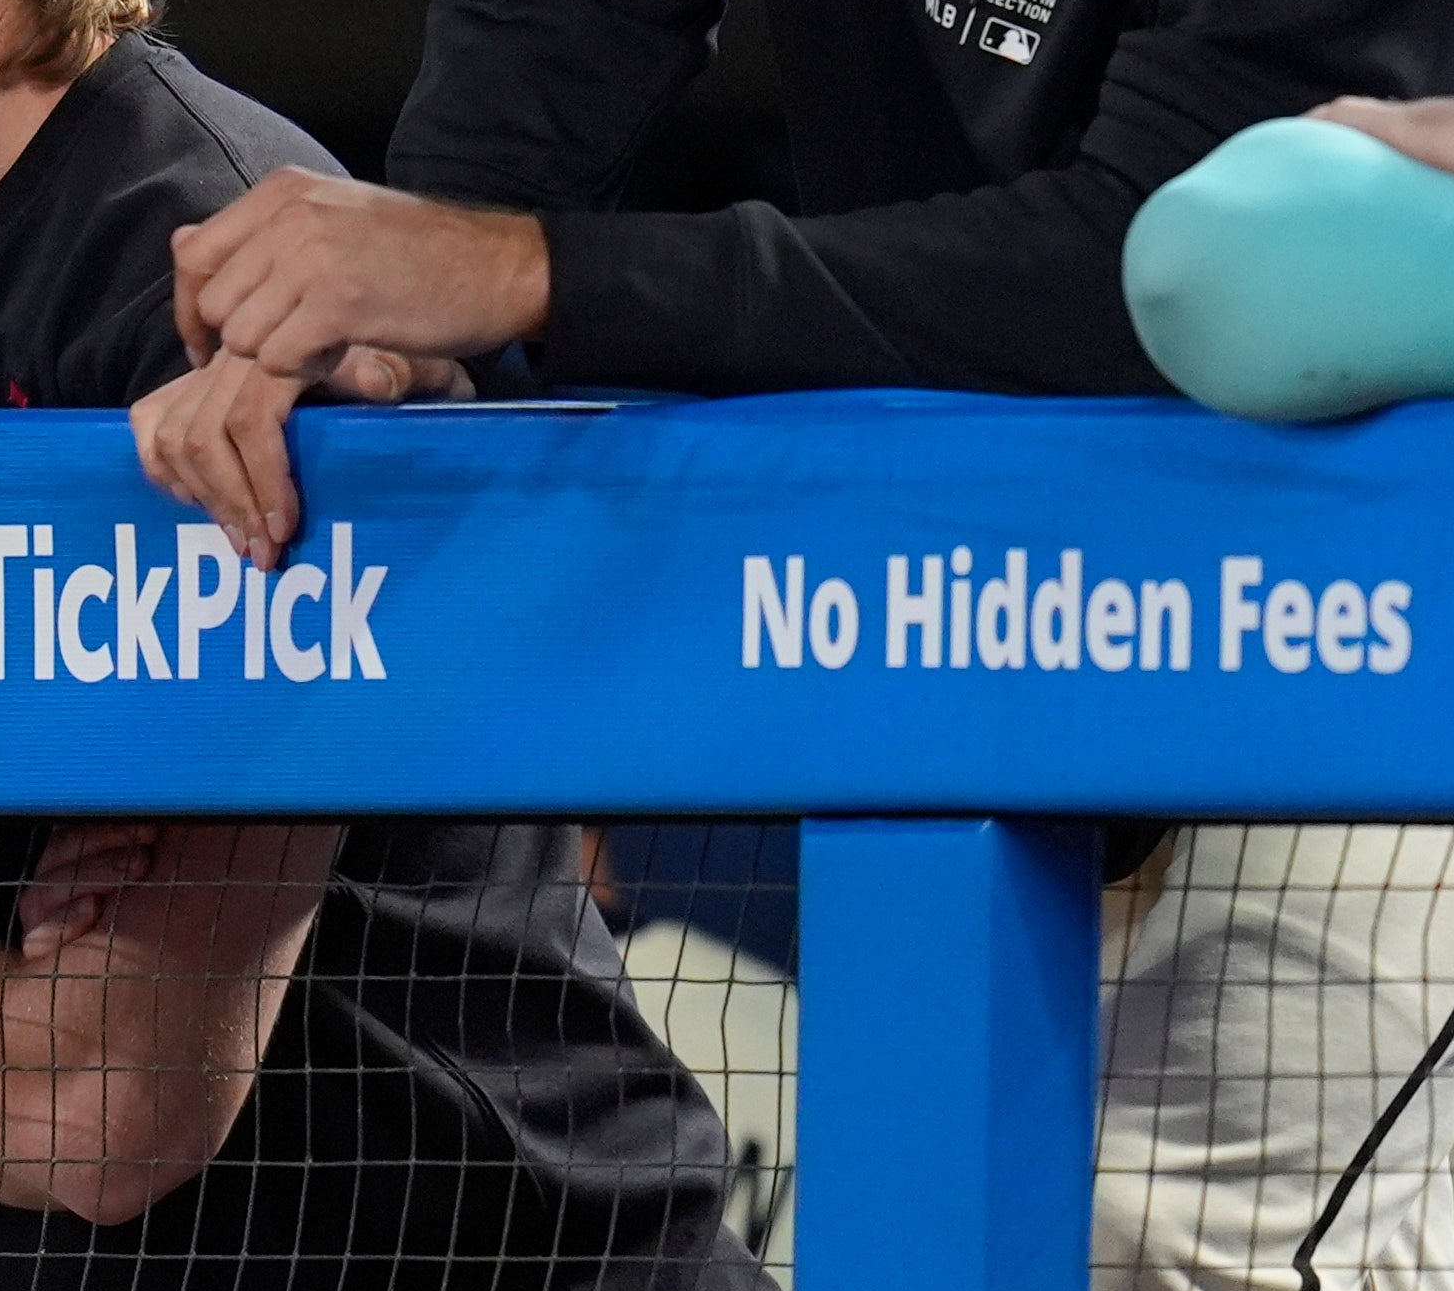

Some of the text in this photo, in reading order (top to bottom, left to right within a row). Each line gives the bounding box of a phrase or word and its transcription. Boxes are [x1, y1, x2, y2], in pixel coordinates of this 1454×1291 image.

[742, 546, 1412, 675] No Hidden Fees
